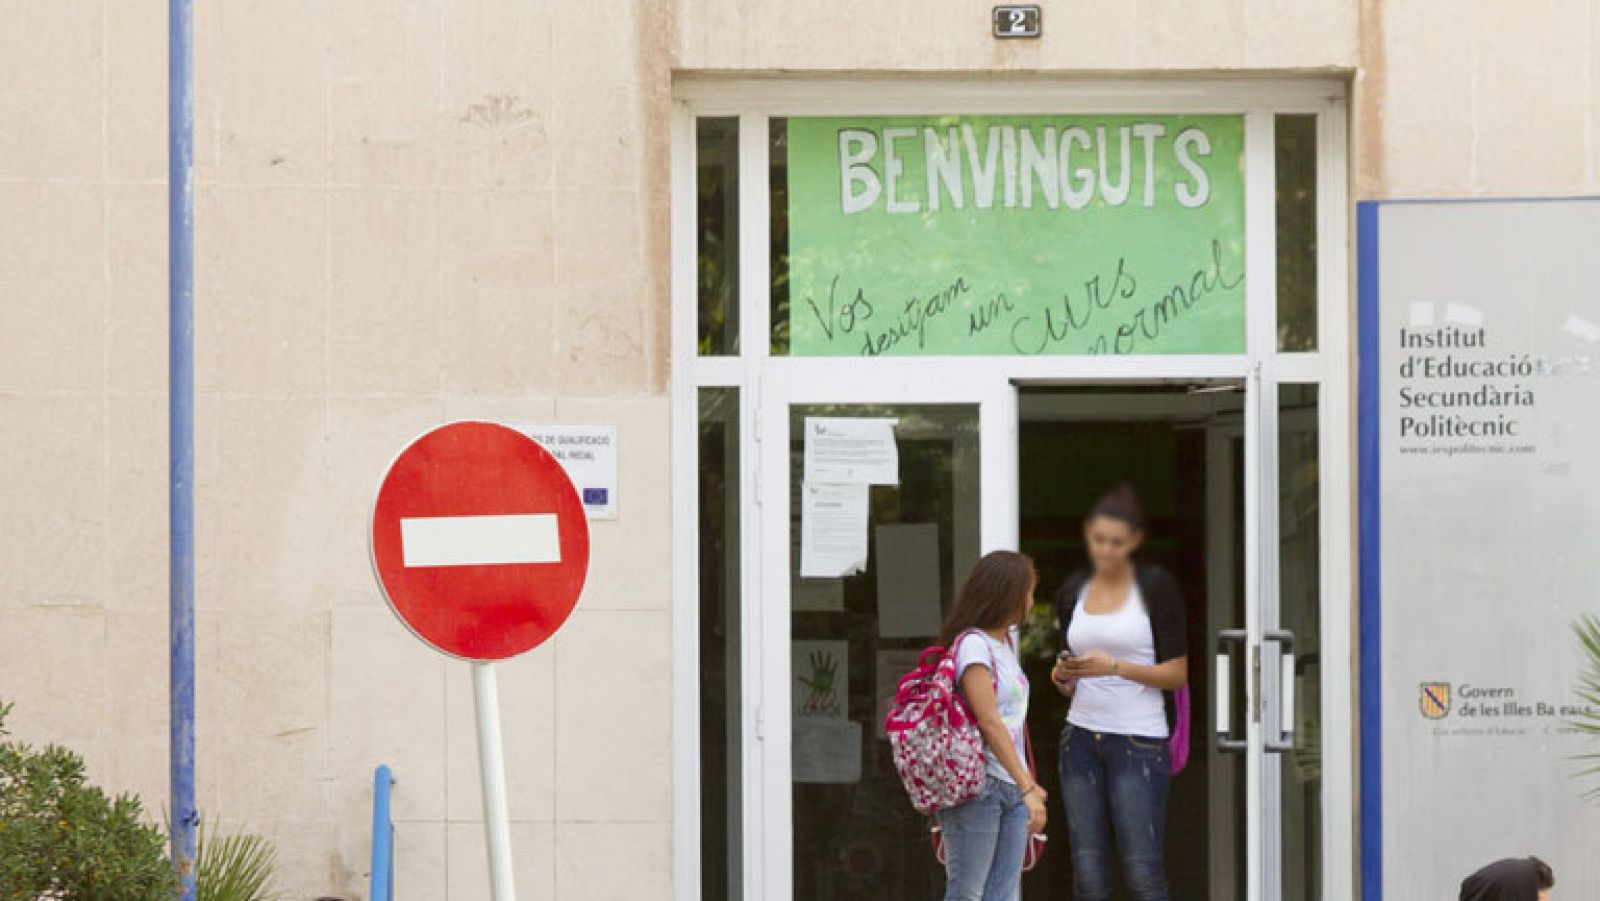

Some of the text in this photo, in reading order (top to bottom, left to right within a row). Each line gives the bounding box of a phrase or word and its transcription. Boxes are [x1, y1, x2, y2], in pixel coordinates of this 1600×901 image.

[1009, 9, 1026, 32] 2
[837, 122, 1212, 215] BENVINGUTS
[806, 273, 874, 341] Vos
[860, 275, 970, 356] desitjam
[967, 292, 1014, 337] un
[1400, 326, 1486, 349] Institut
[1400, 354, 1533, 378] d'Educació
[1400, 384, 1535, 408] Secundària
[1400, 413, 1518, 437] Politècnic
[1457, 684, 1514, 699] Govern
[1458, 703, 1476, 717] de
[1480, 703, 1500, 717] les
[1503, 702, 1532, 717] Illes
